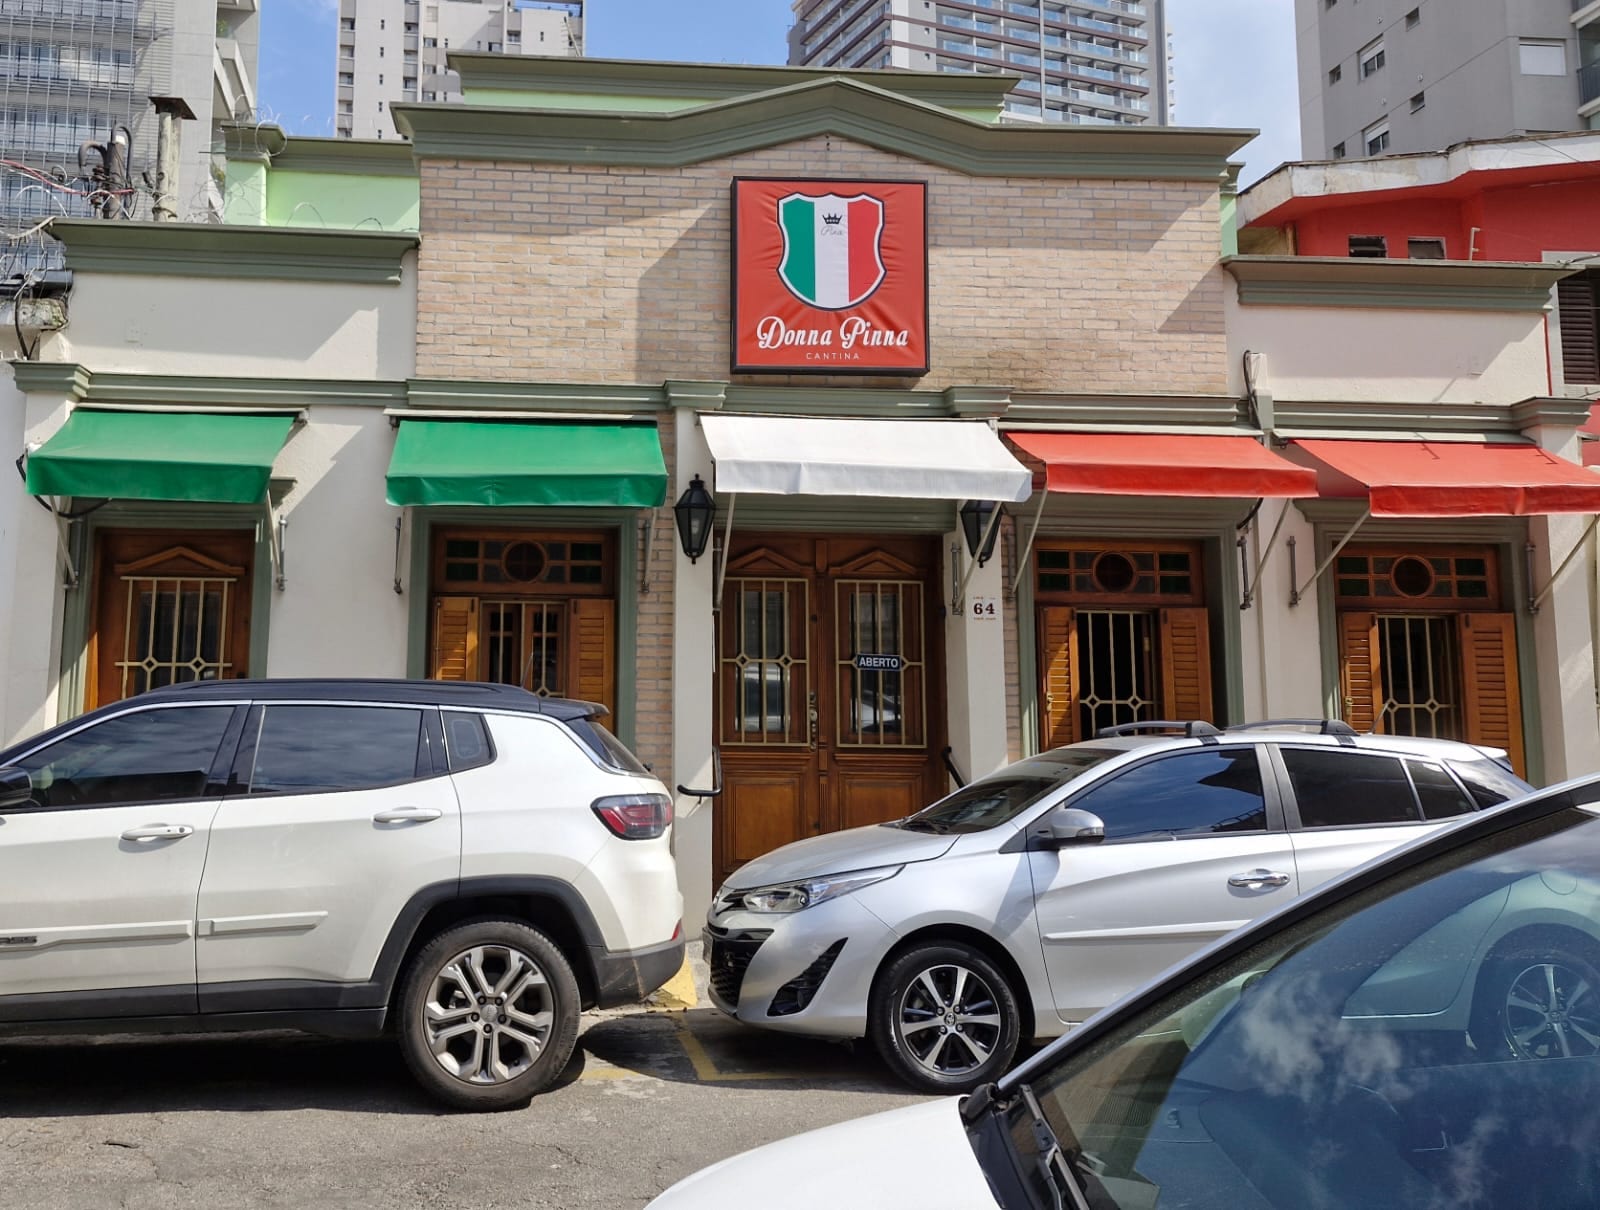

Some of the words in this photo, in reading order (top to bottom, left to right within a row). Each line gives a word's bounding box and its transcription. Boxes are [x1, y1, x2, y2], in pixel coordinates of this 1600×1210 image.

[756, 315, 832, 349] Donna
[840, 316, 908, 349] Pinna
[806, 352, 860, 360] CANTINA
[973, 602, 995, 615] 64
[859, 656, 899, 668] ABERTO
